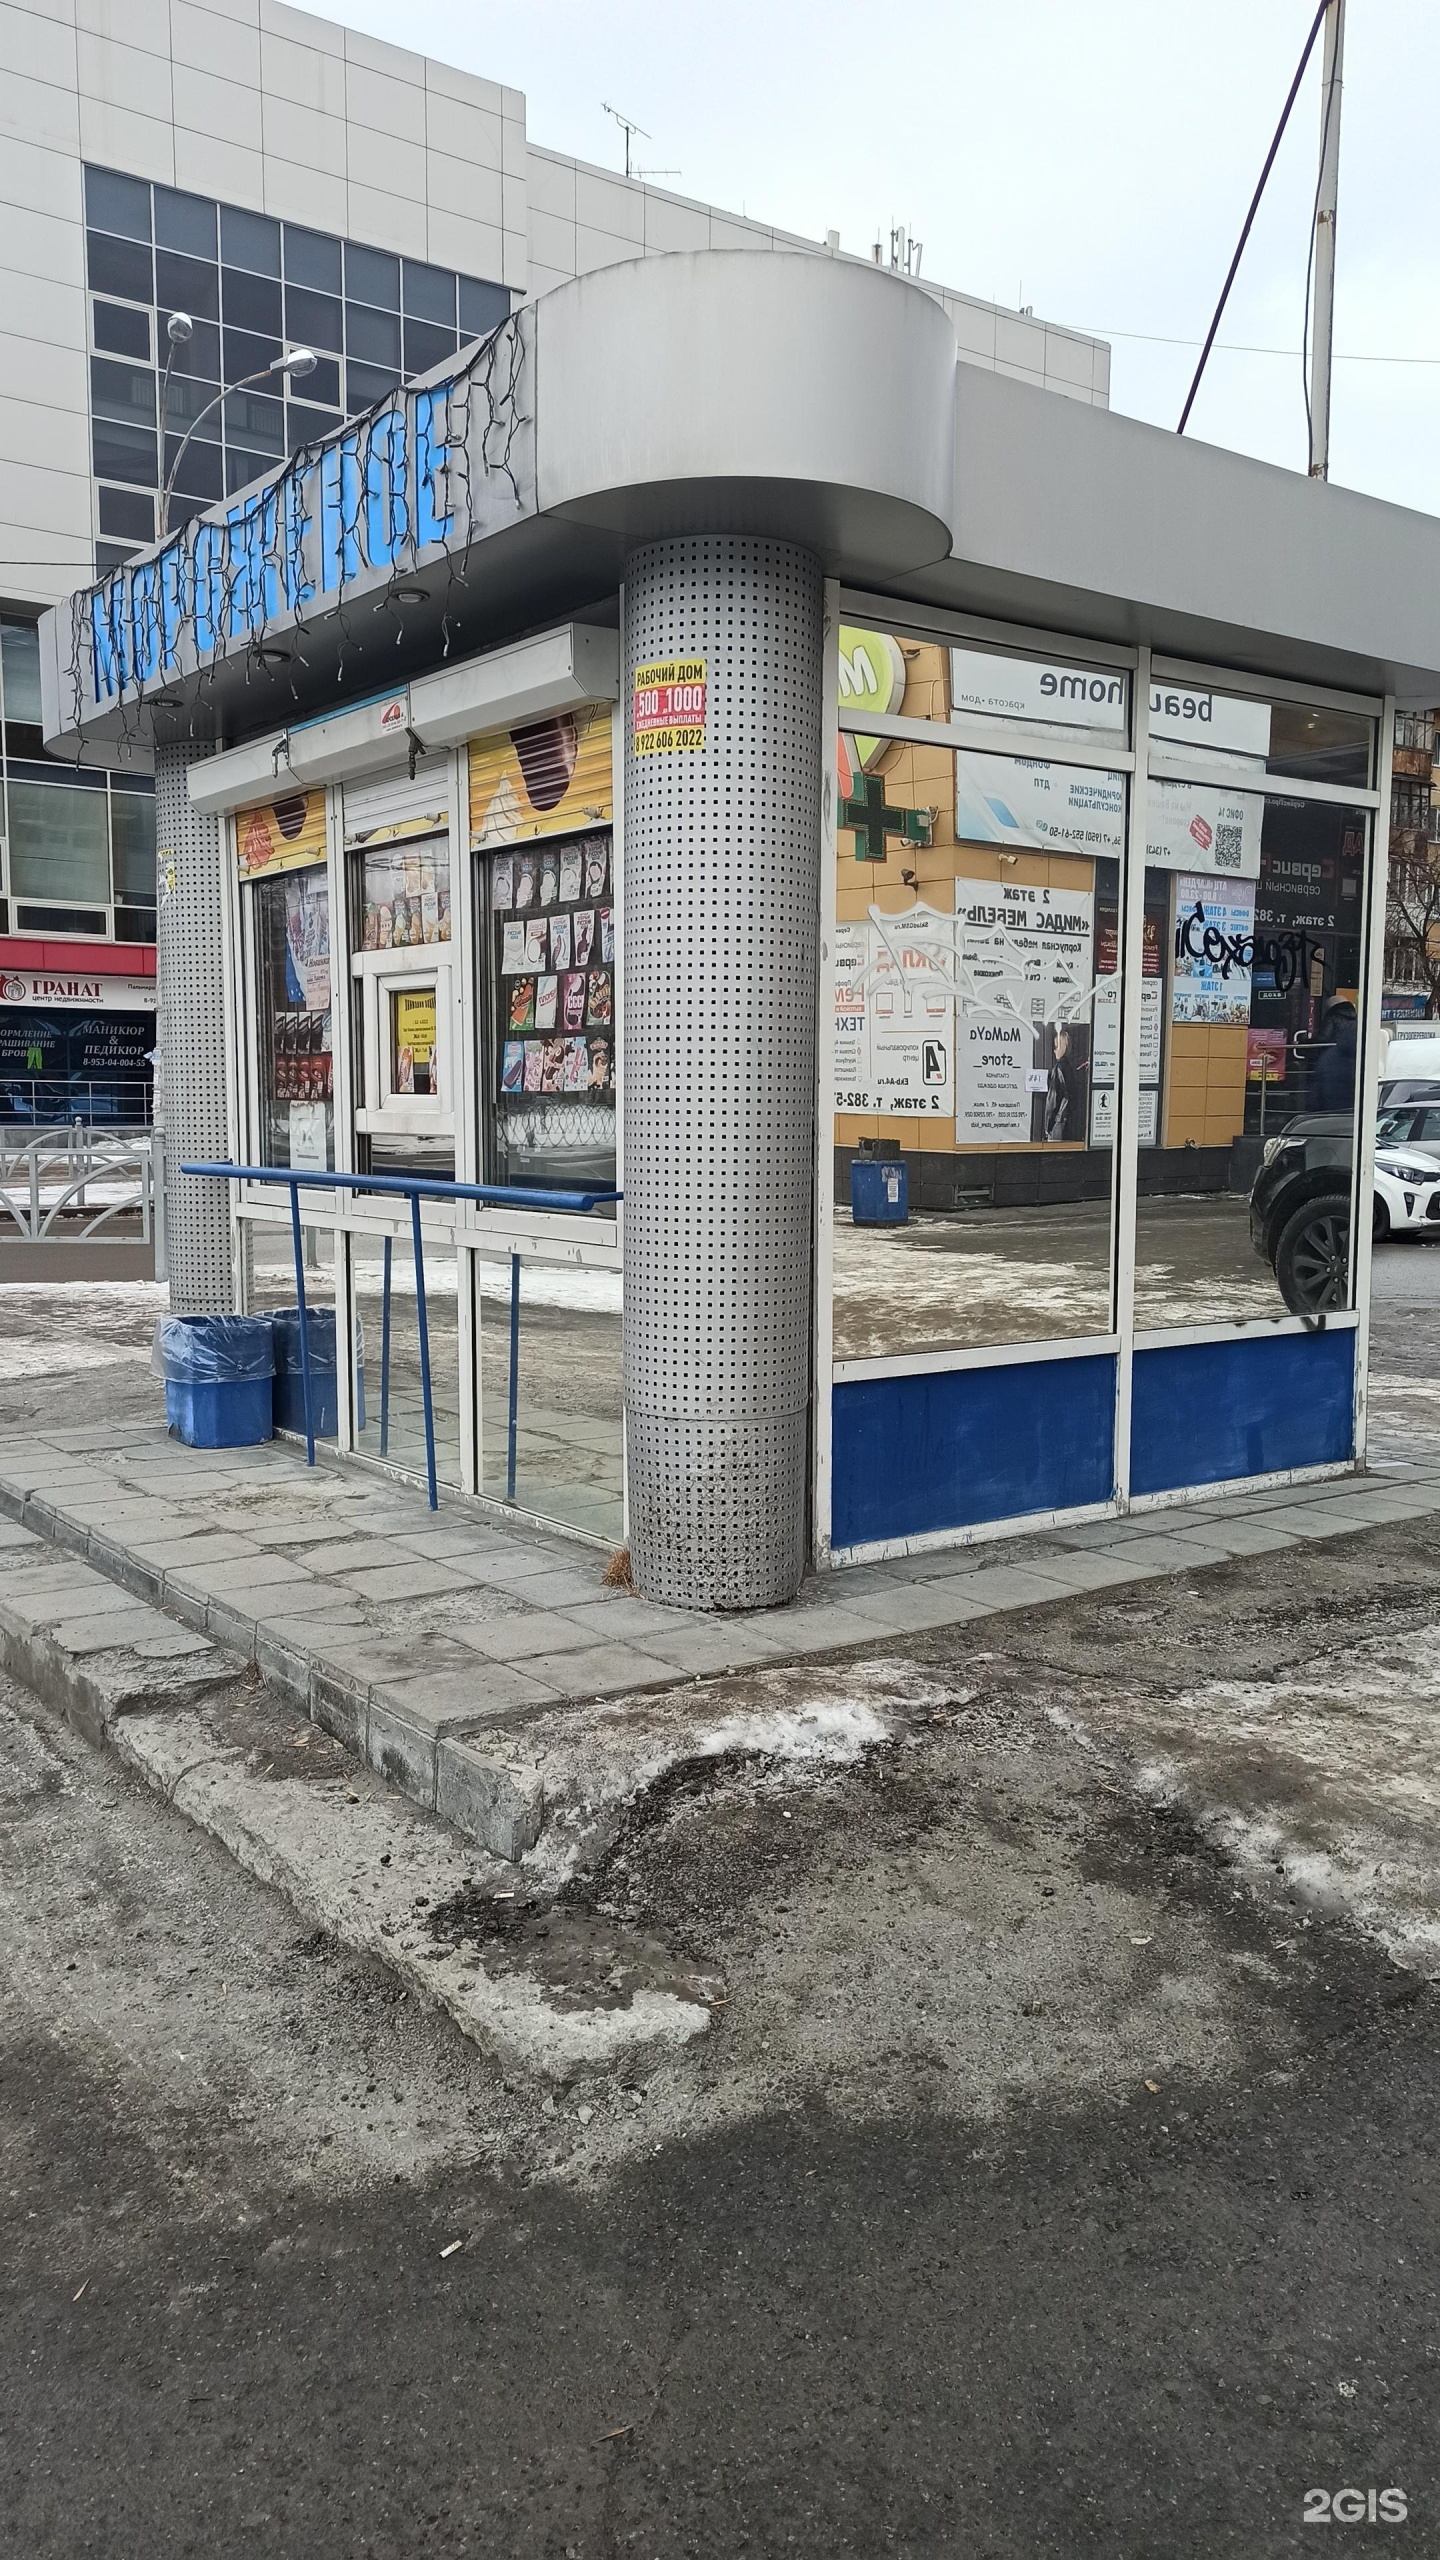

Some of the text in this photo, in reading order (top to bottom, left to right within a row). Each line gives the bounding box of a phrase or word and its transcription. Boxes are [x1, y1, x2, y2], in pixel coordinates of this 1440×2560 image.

[637, 663, 703, 687] РАБОЧИЙ ДОМ
[666, 685, 703, 712] 1000
[669, 714, 702, 725] ВЫПЛАТЫ
[635, 729, 703, 752] 8 922 606 2022
[32, 980, 103, 997] ГРАНАТ
[32, 995, 104, 1004] центр недвижимости
[82, 1025, 145, 1036] МАНИКЮР
[108, 1035, 119, 1045] &
[84, 1045, 145, 1056] ПЕДИКЮР
[82, 1058, 146, 1067] 8-953-04-004-55
